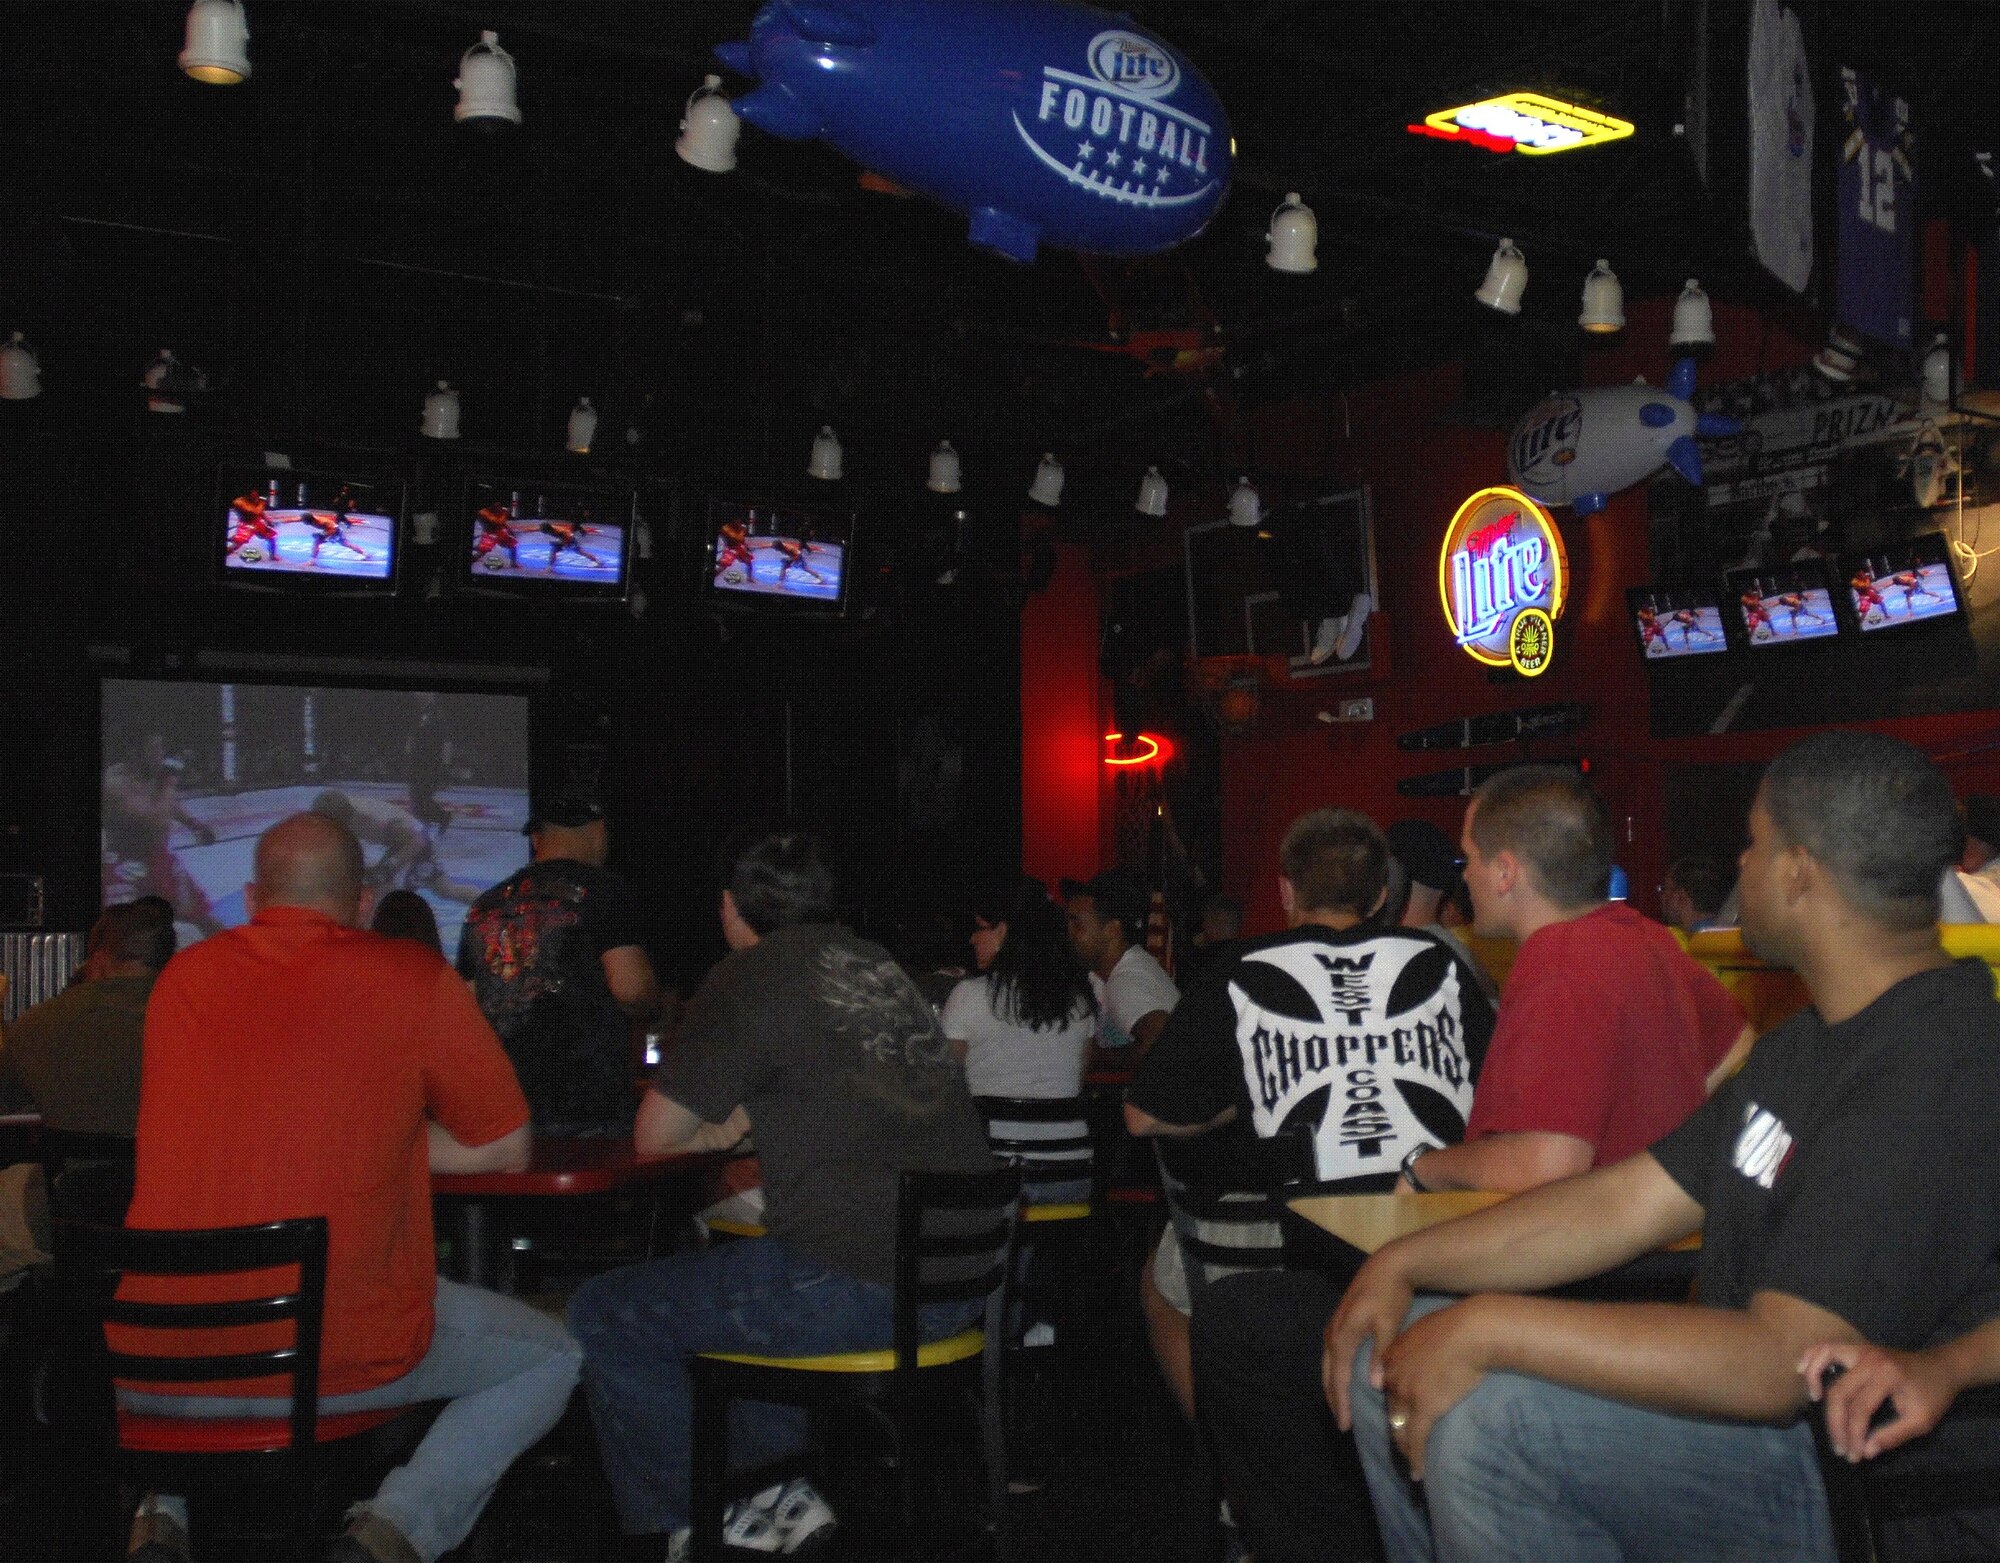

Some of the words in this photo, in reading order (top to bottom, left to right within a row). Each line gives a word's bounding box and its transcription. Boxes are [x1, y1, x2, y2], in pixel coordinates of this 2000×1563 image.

[1109, 51, 1164, 83] Lite
[1038, 80, 1208, 174] FOOTBALL
[1858, 142, 1896, 233] 12
[1519, 408, 1582, 474] Lite
[1453, 536, 1545, 644] Lite
[1520, 656, 1541, 669] BEER
[1312, 952, 1377, 1027] WEST
[1251, 1003, 1464, 1117] CHOPPERS
[1339, 1069, 1398, 1160] COAST
